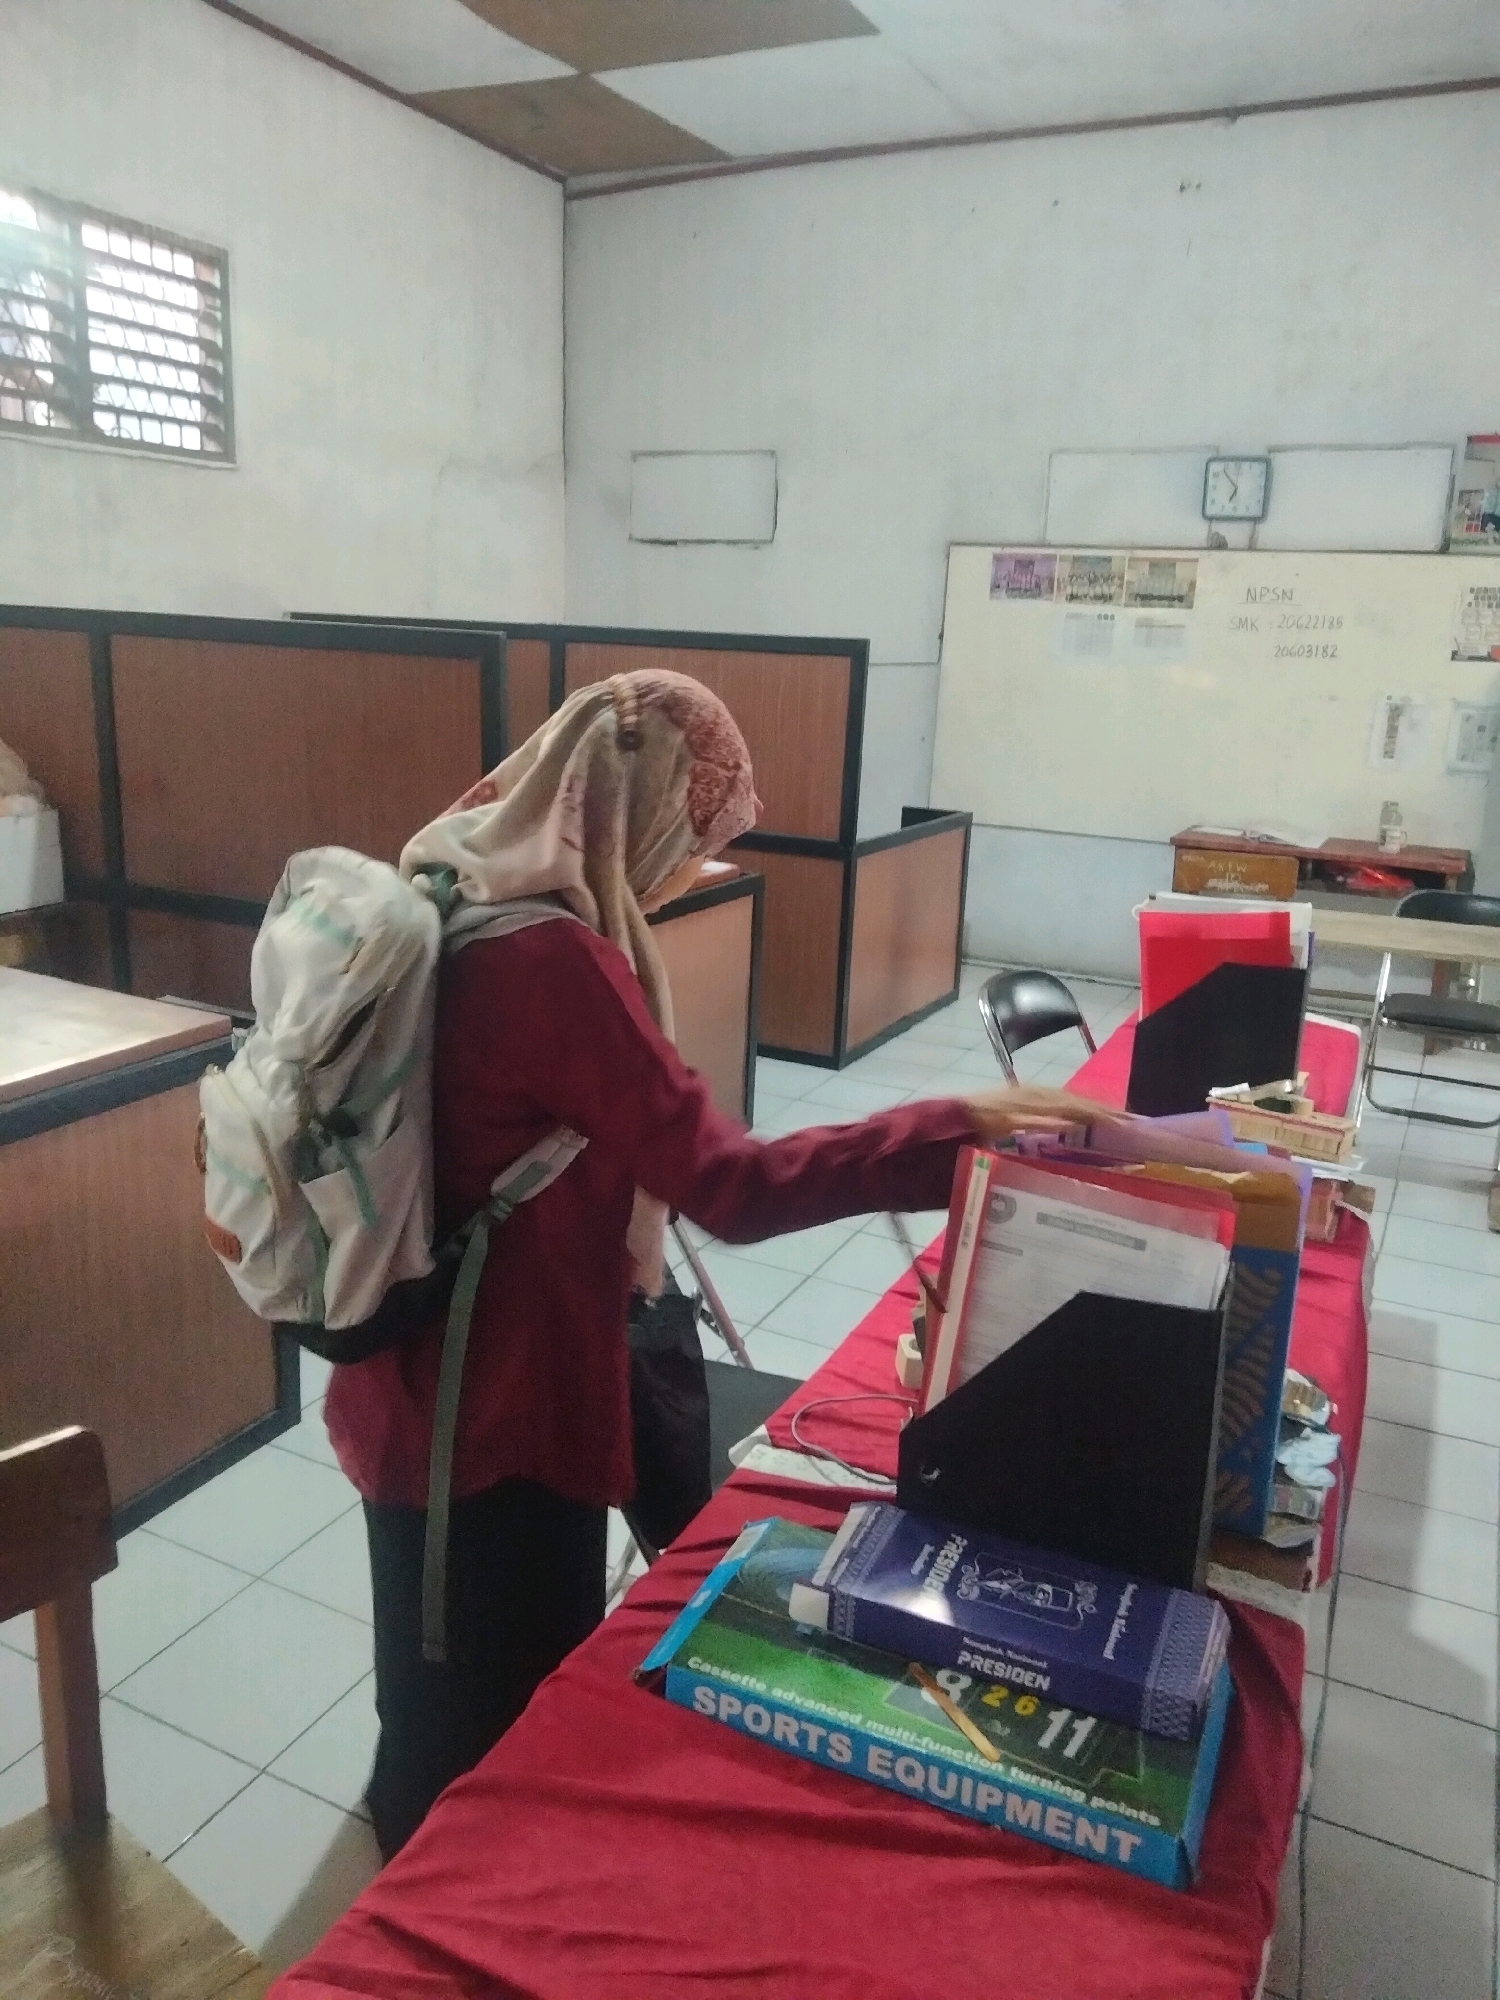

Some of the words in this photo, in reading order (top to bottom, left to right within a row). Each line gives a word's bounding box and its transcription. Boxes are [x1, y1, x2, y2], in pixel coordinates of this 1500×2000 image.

[1246, 586, 1294, 603] NPSN
[1229, 615, 1259, 632] SMK
[1274, 643, 1338, 659] 20603182
[957, 1650, 1051, 1692] PRESIDEN
[981, 1684, 1010, 1708] 2
[1037, 1707, 1098, 1759] 11
[692, 1685, 853, 1764] SPORTS
[866, 1744, 1142, 1863] EQUIPMENT
[771, 1687, 863, 1725] advanced
[865, 1718, 1005, 1773] multi-function
[1010, 1765, 1086, 1806] turning
[1089, 1794, 1161, 1827] points
